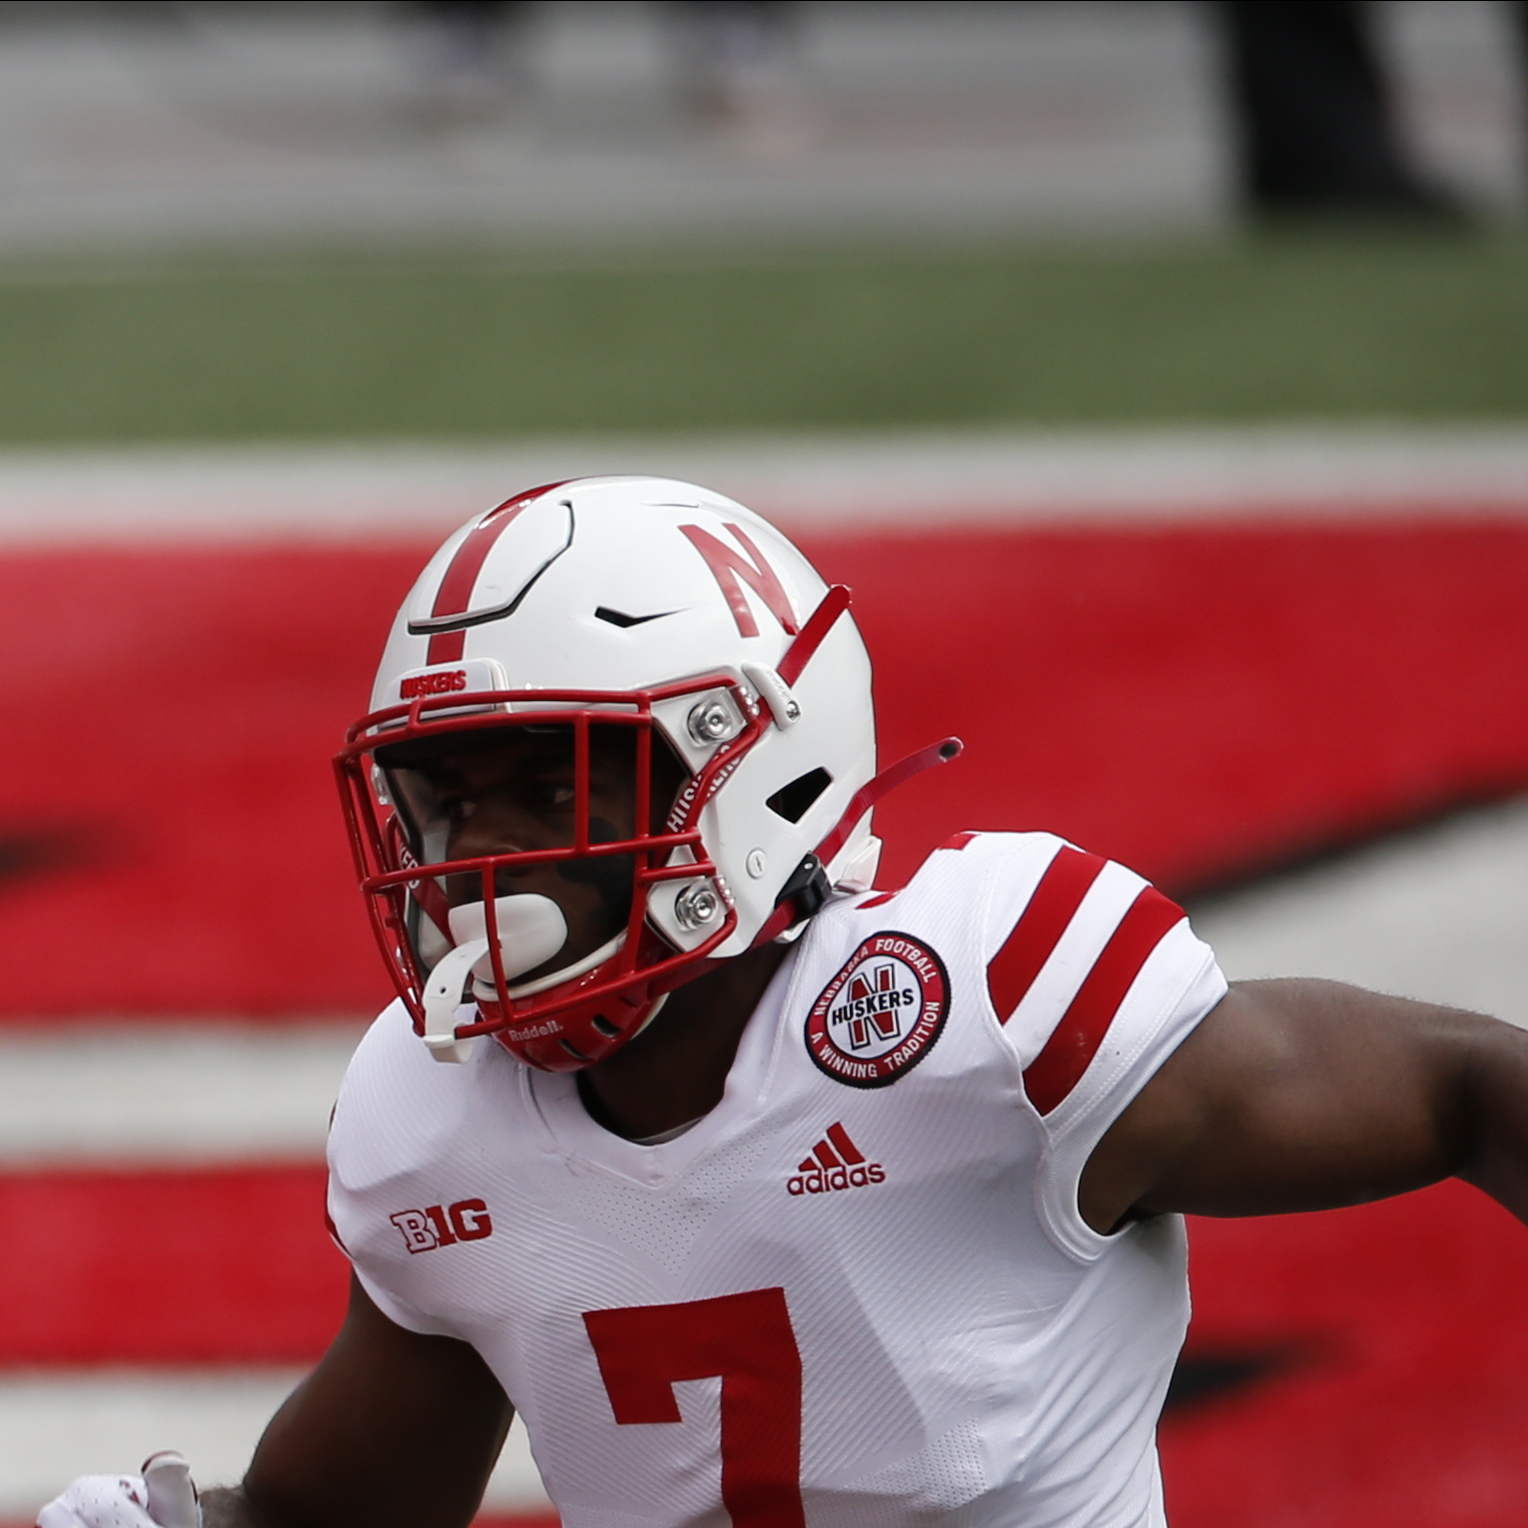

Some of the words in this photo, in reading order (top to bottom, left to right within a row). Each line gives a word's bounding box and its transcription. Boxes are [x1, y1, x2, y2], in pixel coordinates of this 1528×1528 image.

[677, 523, 801, 638] N
[399, 670, 467, 700] HUSKERS
[875, 938, 937, 984] FOOTBALL
[832, 988, 915, 1027] HUSKERS
[811, 1031, 824, 1044] A
[819, 1044, 878, 1078] WINNING
[883, 1001, 940, 1071] TRADITION
[787, 1163, 886, 1196] adidas
